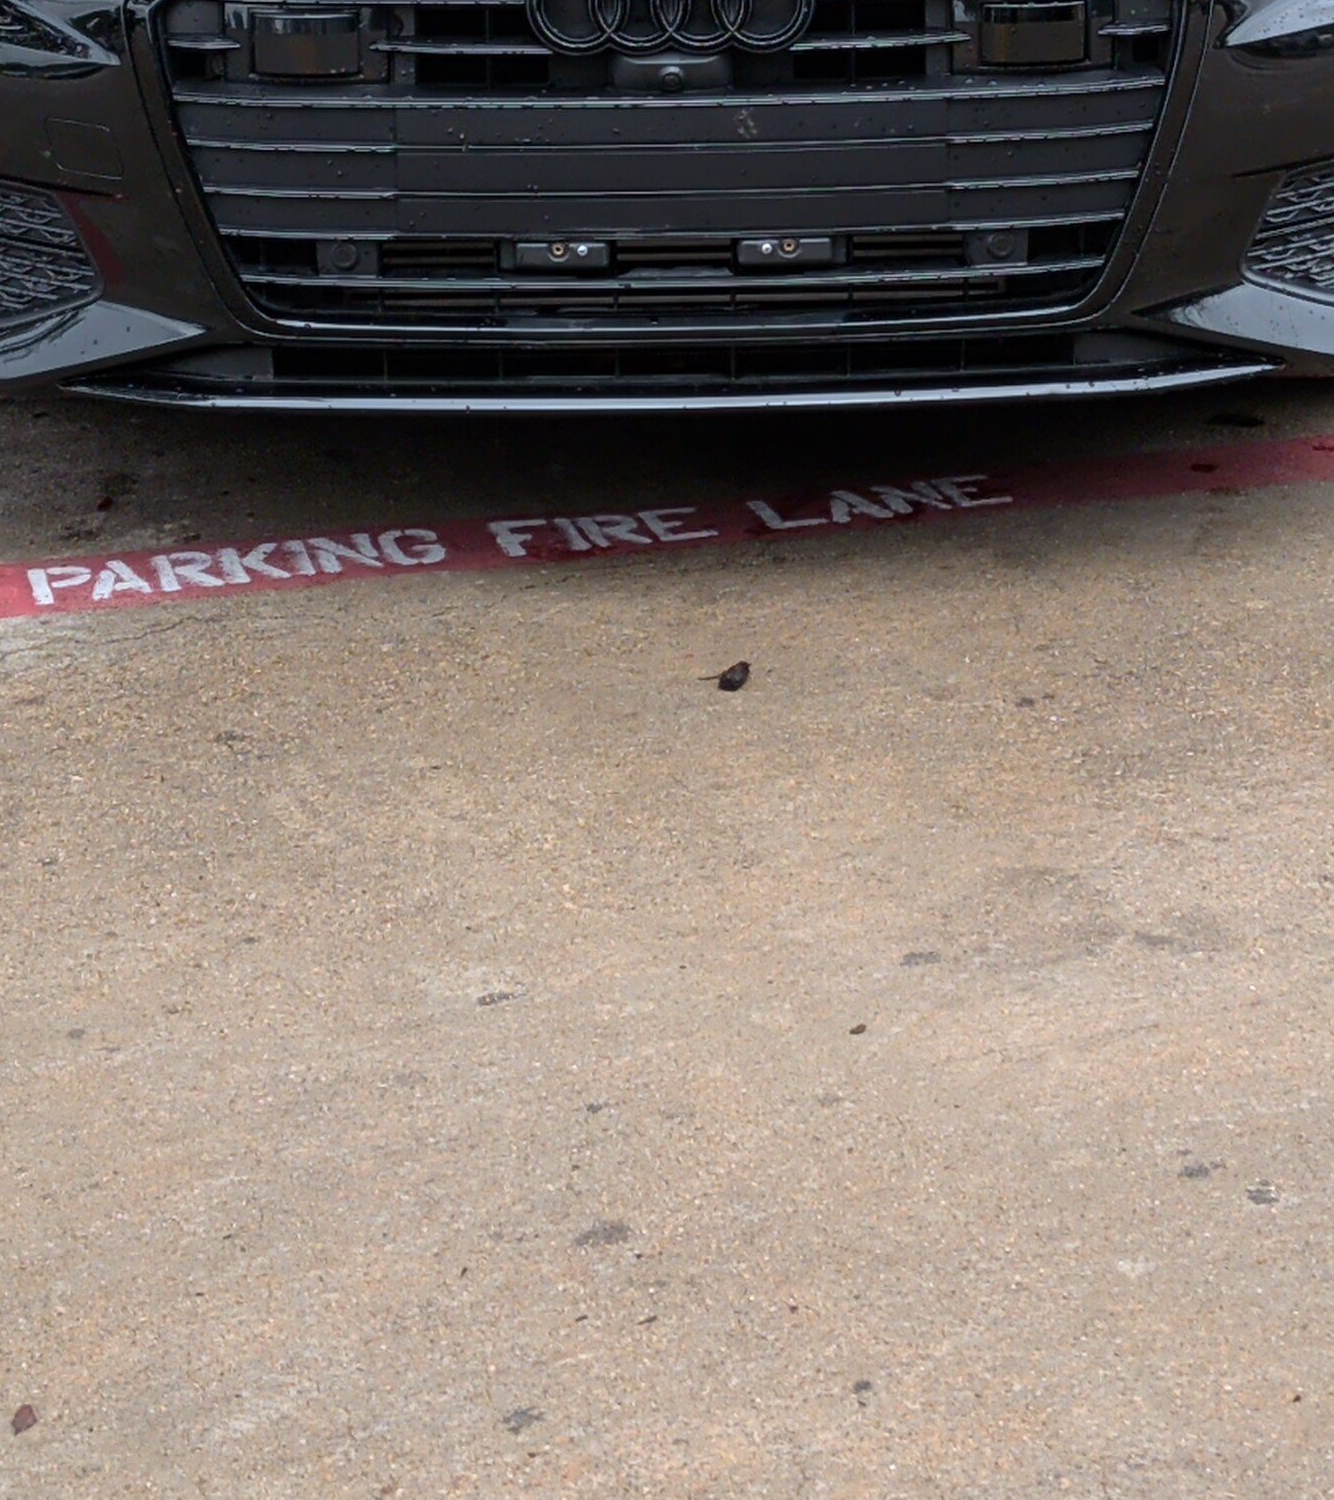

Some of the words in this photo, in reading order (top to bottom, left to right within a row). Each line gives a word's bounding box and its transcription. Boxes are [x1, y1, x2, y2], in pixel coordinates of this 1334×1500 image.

[27, 529, 446, 605] PARKING
[487, 507, 718, 557] FIRE
[746, 475, 1013, 529] LANE
